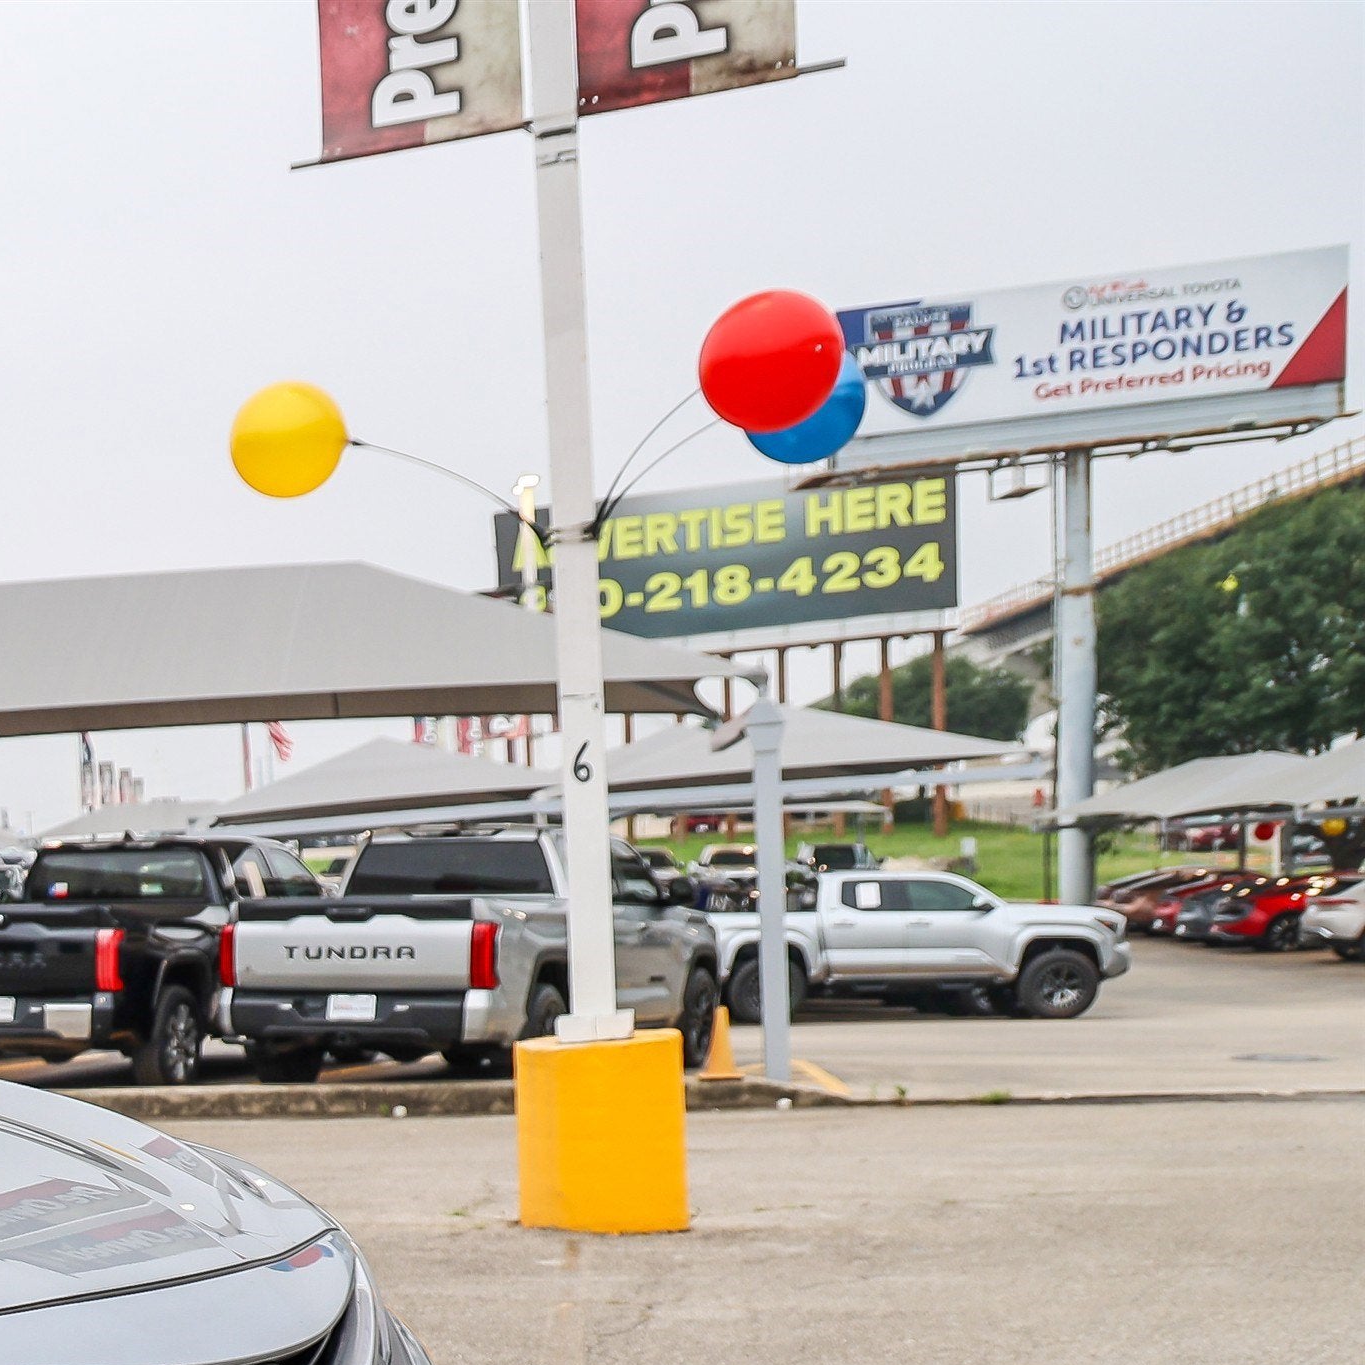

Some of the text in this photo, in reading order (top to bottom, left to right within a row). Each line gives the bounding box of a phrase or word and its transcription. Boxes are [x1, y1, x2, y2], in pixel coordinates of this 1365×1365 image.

[632, 0, 727, 68] P
[372, 0, 461, 128] Pre
[1183, 277, 1241, 296] TOYOTA
[1059, 299, 1249, 344] MILITARY &
[856, 331, 988, 370] MILITARY
[1013, 322, 1296, 380] 1st RESPONDERS
[1033, 359, 1271, 400] Get Preferred Pricing
[512, 477, 947, 573] AERTISE HERE
[521, 541, 945, 620] 0-218-4234
[573, 741, 590, 782] 6
[283, 945, 416, 960] TUNDRA
